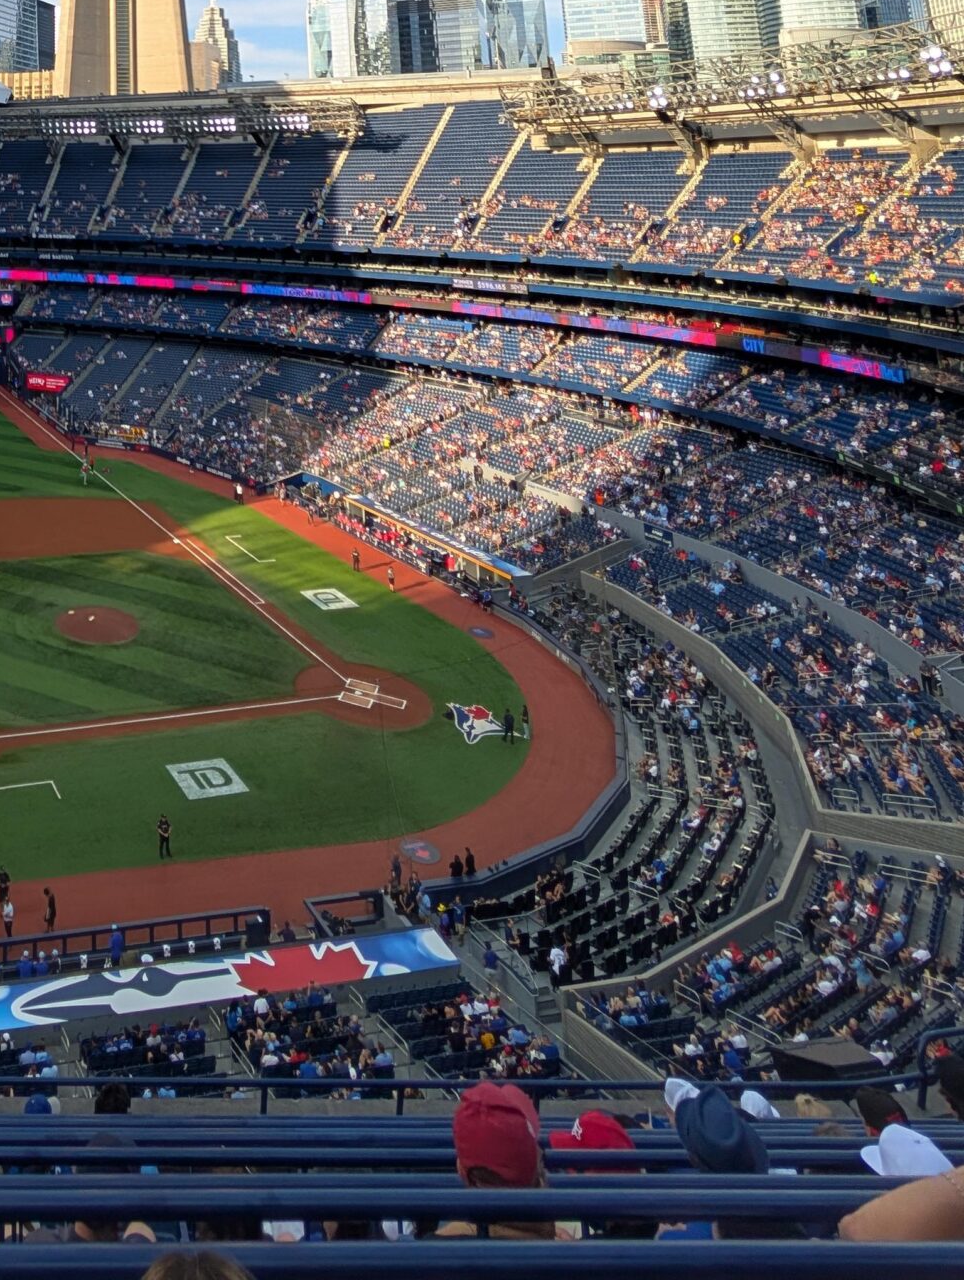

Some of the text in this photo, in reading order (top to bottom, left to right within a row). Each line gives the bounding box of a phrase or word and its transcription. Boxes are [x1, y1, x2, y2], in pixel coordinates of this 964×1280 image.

[743, 338, 764, 353] CITY
[314, 591, 344, 608] TD
[177, 766, 233, 790] TD
